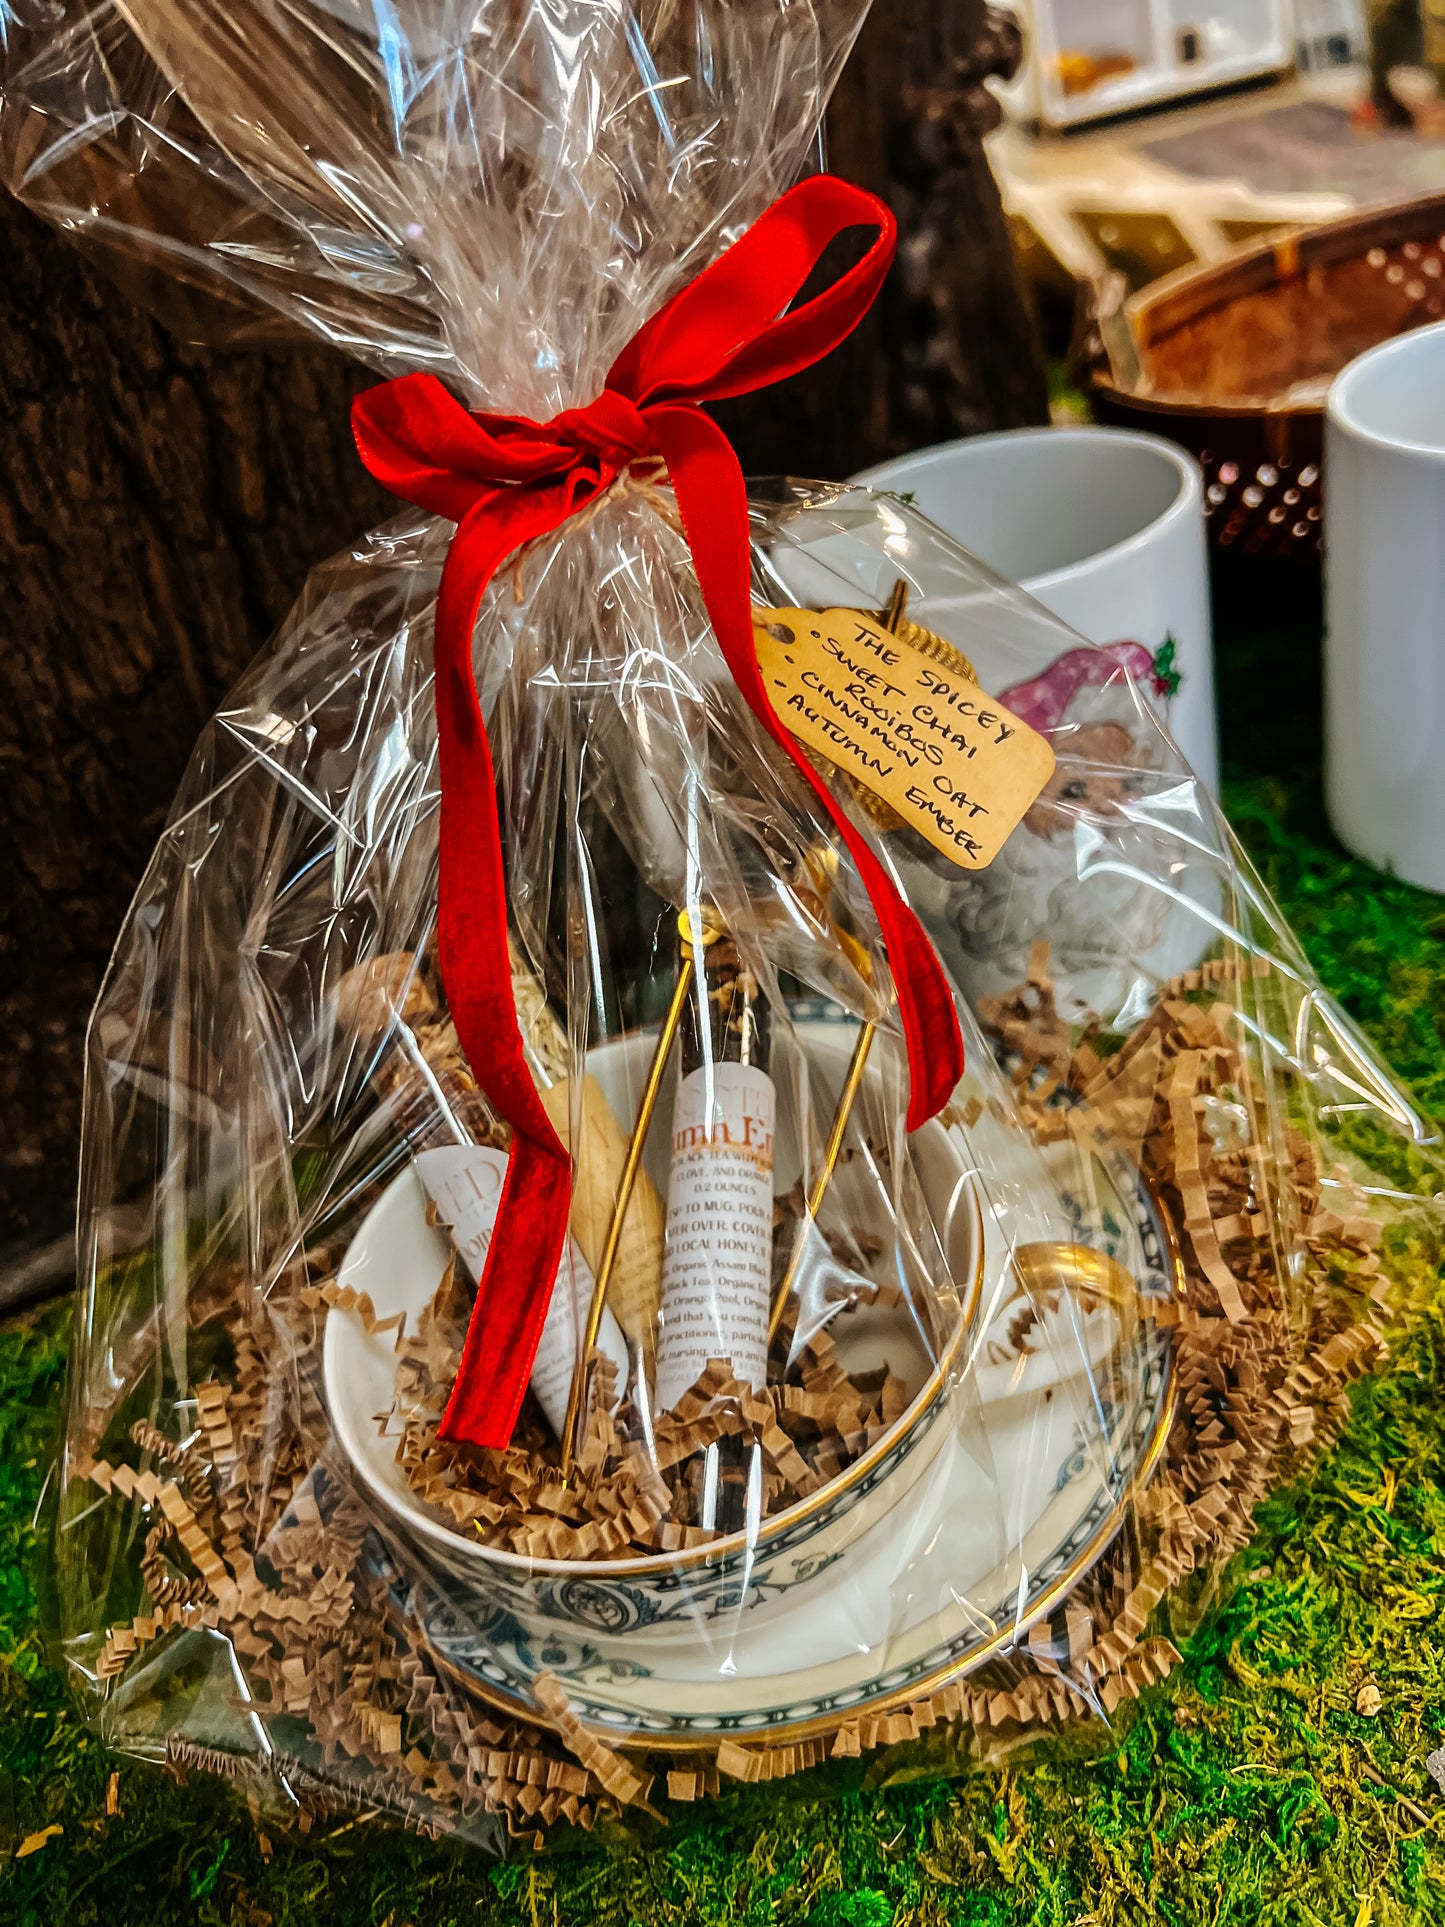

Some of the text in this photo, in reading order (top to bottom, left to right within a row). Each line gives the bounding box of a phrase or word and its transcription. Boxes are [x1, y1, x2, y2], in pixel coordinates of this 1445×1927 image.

[853, 623, 1016, 745] THE SPICEY
[821, 637, 977, 759] SWEET CHAI
[800, 671, 990, 819] CINNAMON OAT
[786, 694, 983, 861] AUTUMN EMBER
[712, 1166, 736, 1177] AND
[693, 1183, 757, 1195] 0.2 OUNCES
[704, 1201, 735, 1212] MUG.
[676, 1238, 712, 1253] LOCAL
[712, 1259, 746, 1270] Assam
[718, 1276, 756, 1289] Organic
[683, 1312, 704, 1322] that
[707, 1312, 728, 1323] yu
